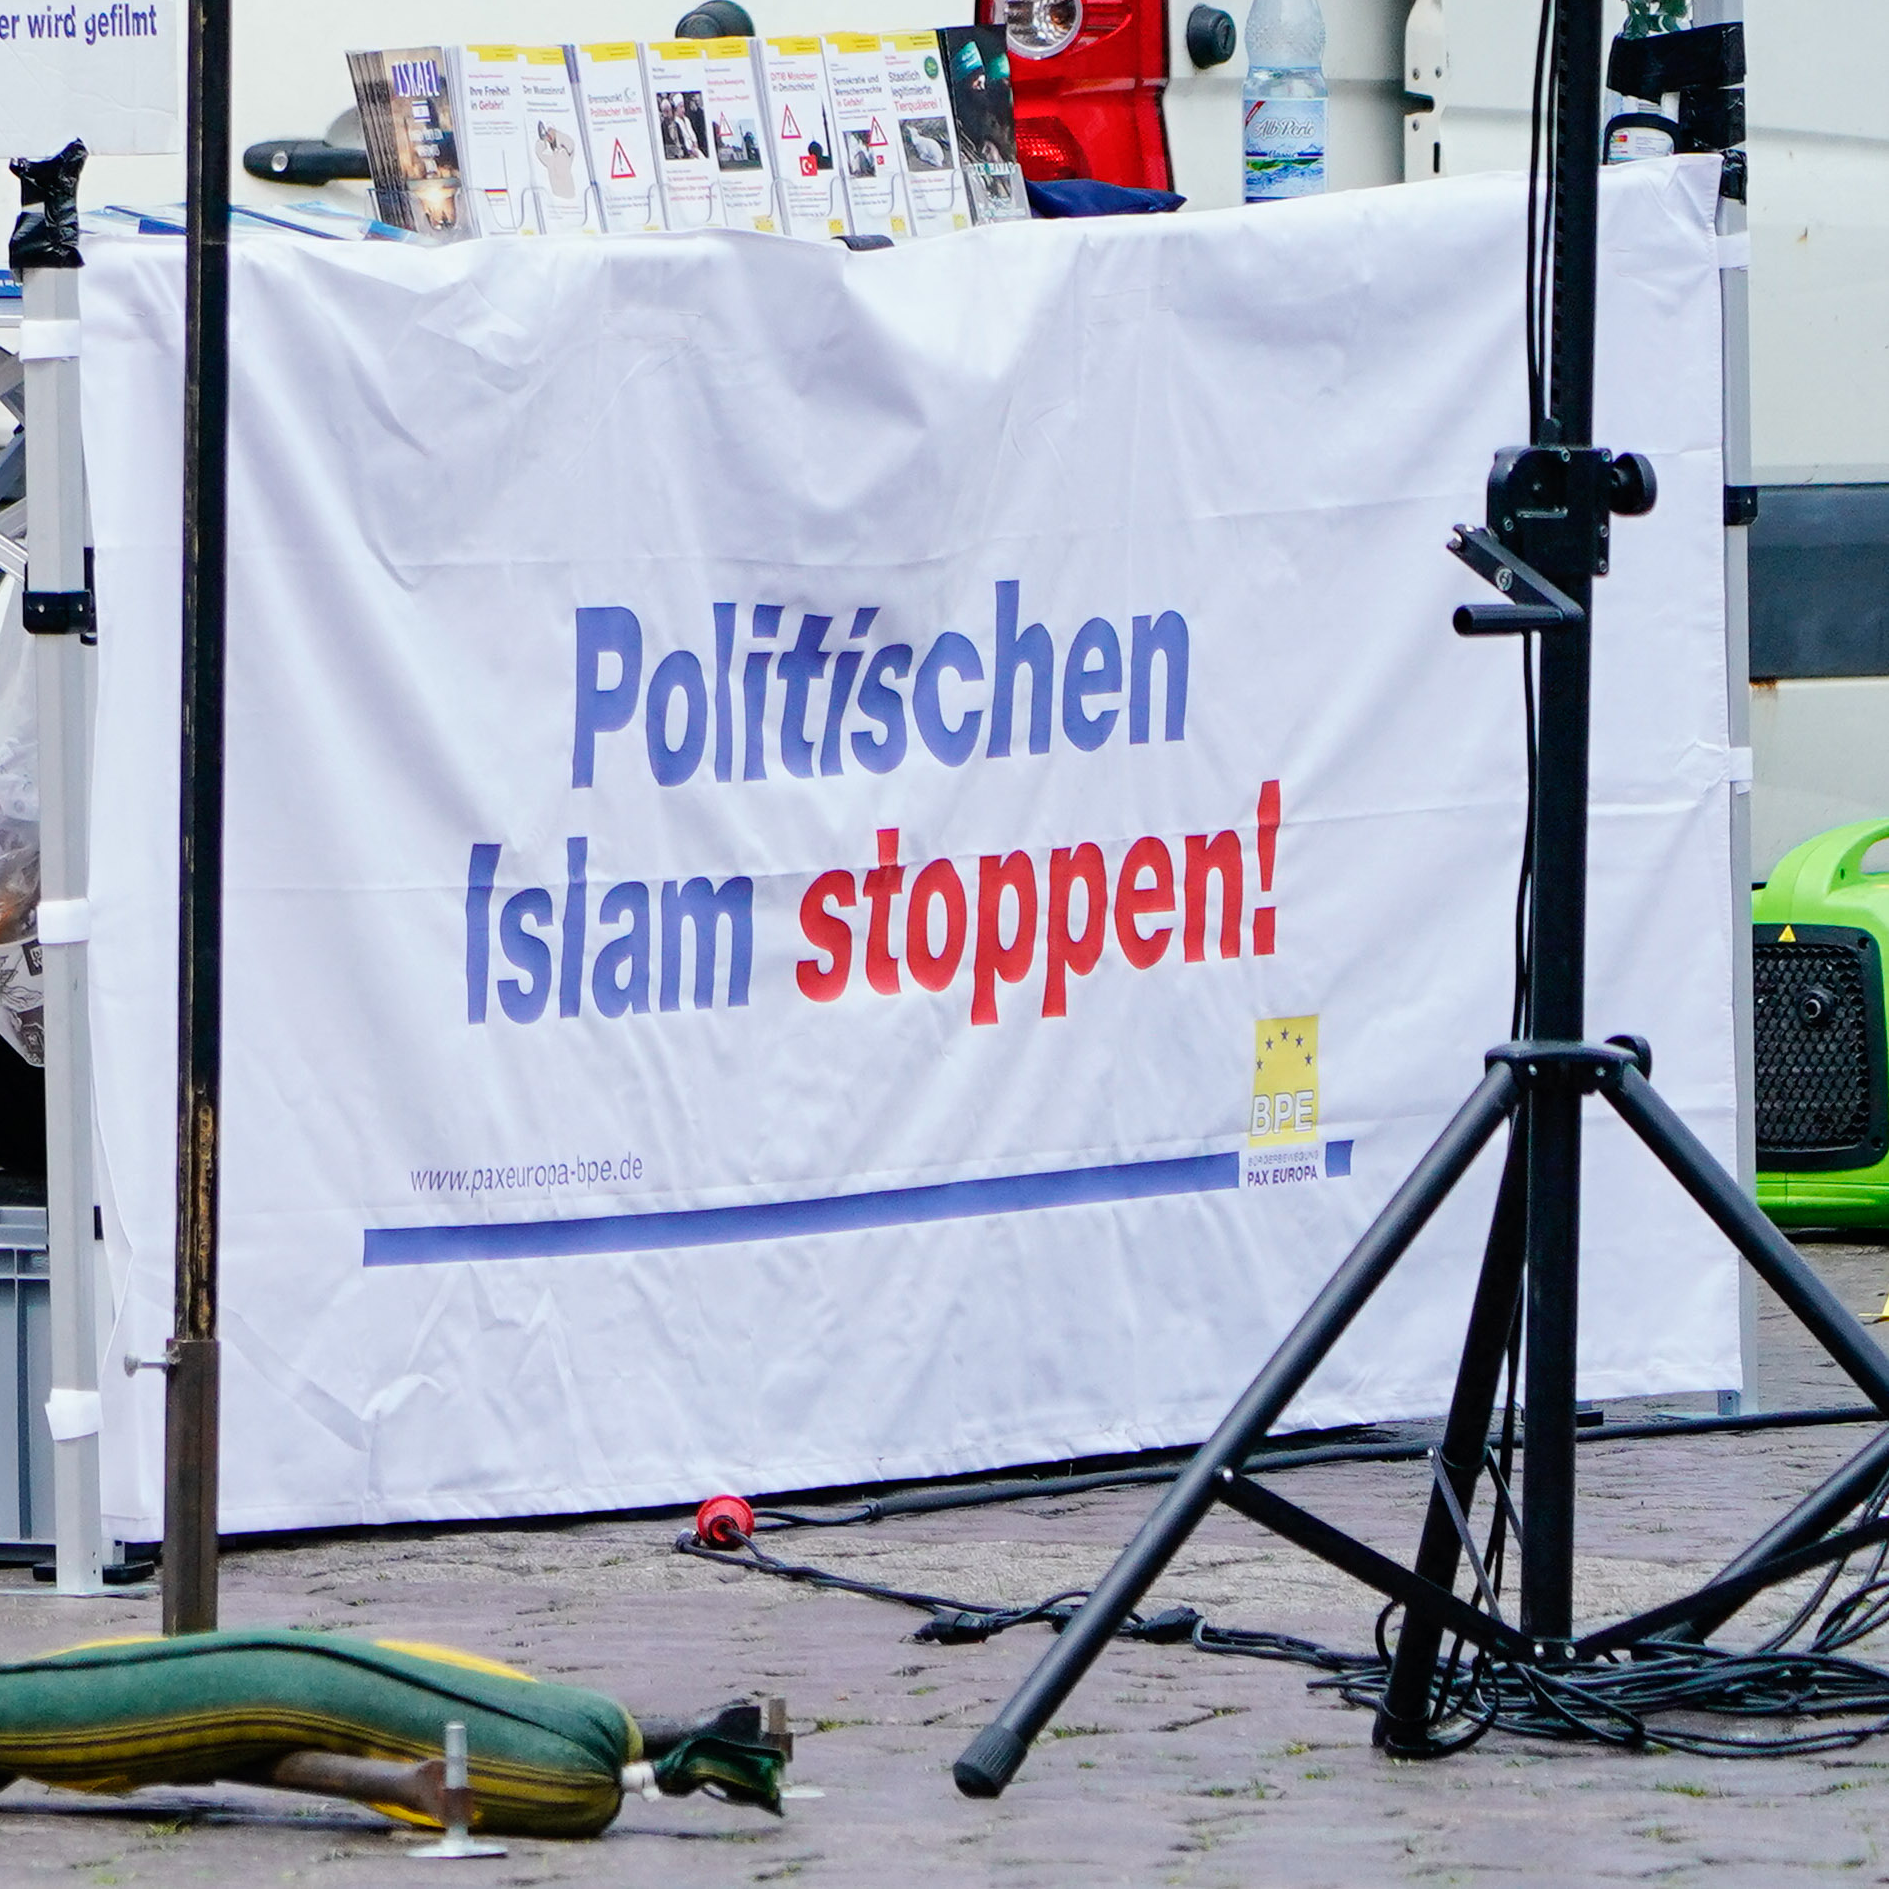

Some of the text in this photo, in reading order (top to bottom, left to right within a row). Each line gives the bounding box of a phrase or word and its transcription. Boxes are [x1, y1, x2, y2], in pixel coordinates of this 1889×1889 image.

[27, 4, 78, 39] wird
[84, 3, 158, 46] gefilmt
[393, 60, 440, 98] ISRAEL
[570, 579, 1191, 790] Politischen
[465, 779, 1281, 1027] Islam stoppen!
[1250, 1089, 1314, 1136] BPE
[410, 1151, 643, 1198] www.paxeuropa-bpe.de
[1247, 1165, 1318, 1187] PAX EUROPA
